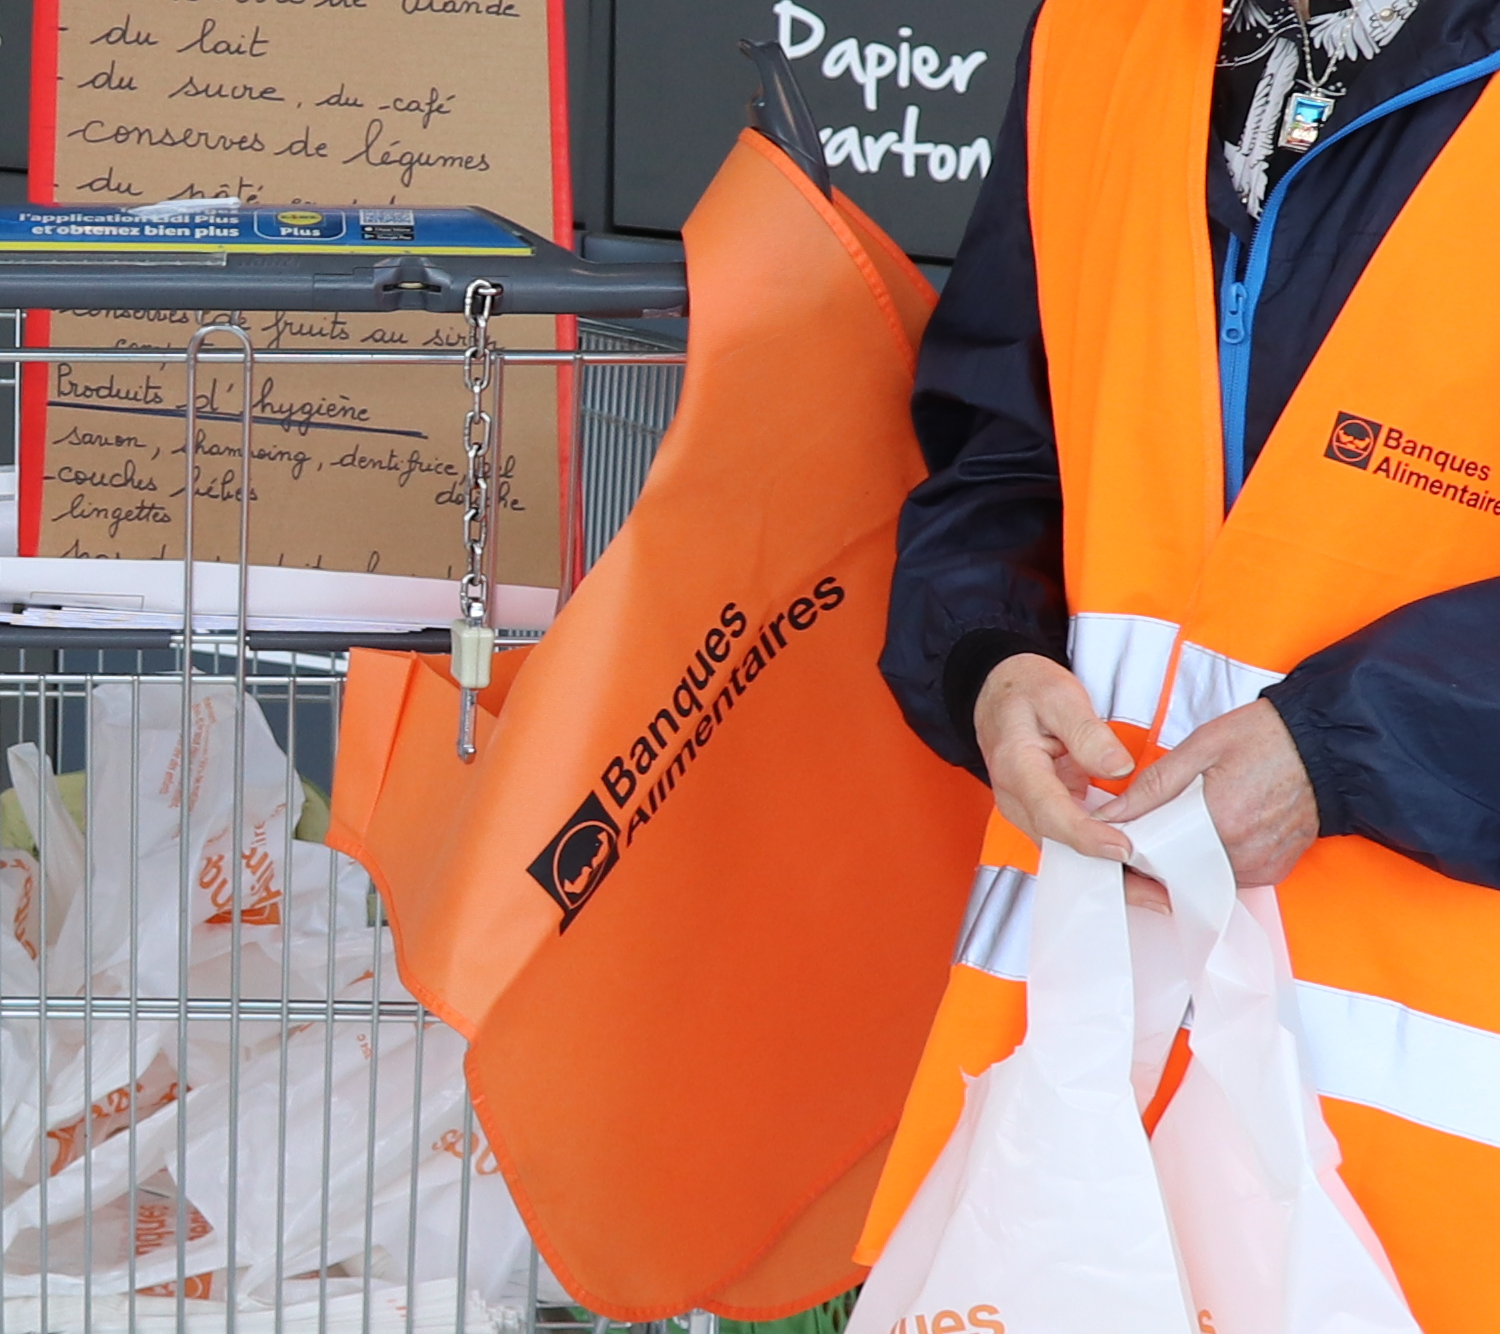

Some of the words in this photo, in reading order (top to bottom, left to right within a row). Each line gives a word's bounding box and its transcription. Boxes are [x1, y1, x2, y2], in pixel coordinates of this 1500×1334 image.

[90, 14, 159, 46] du
[177, 18, 269, 58] lait
[77, 60, 139, 92] du
[316, 82, 364, 109] du
[67, 119, 265, 152] conserves
[275, 128, 329, 157] de
[343, 118, 491, 186] légumes
[818, 105, 993, 183] arton
[77, 168, 142, 197] du
[56, 224, 140, 238] obtenez
[145, 223, 189, 238] bien
[194, 225, 240, 240] plus
[194, 214, 240, 226] Plus
[279, 226, 322, 237] Plus
[266, 308, 351, 351] fruits
[361, 326, 409, 346] au
[56, 362, 164, 406] Produits
[1383, 427, 1492, 482] Banques
[52, 494, 172, 533] lingettes
[600, 600, 749, 808] Banques
[625, 574, 846, 848] Alimentaires
